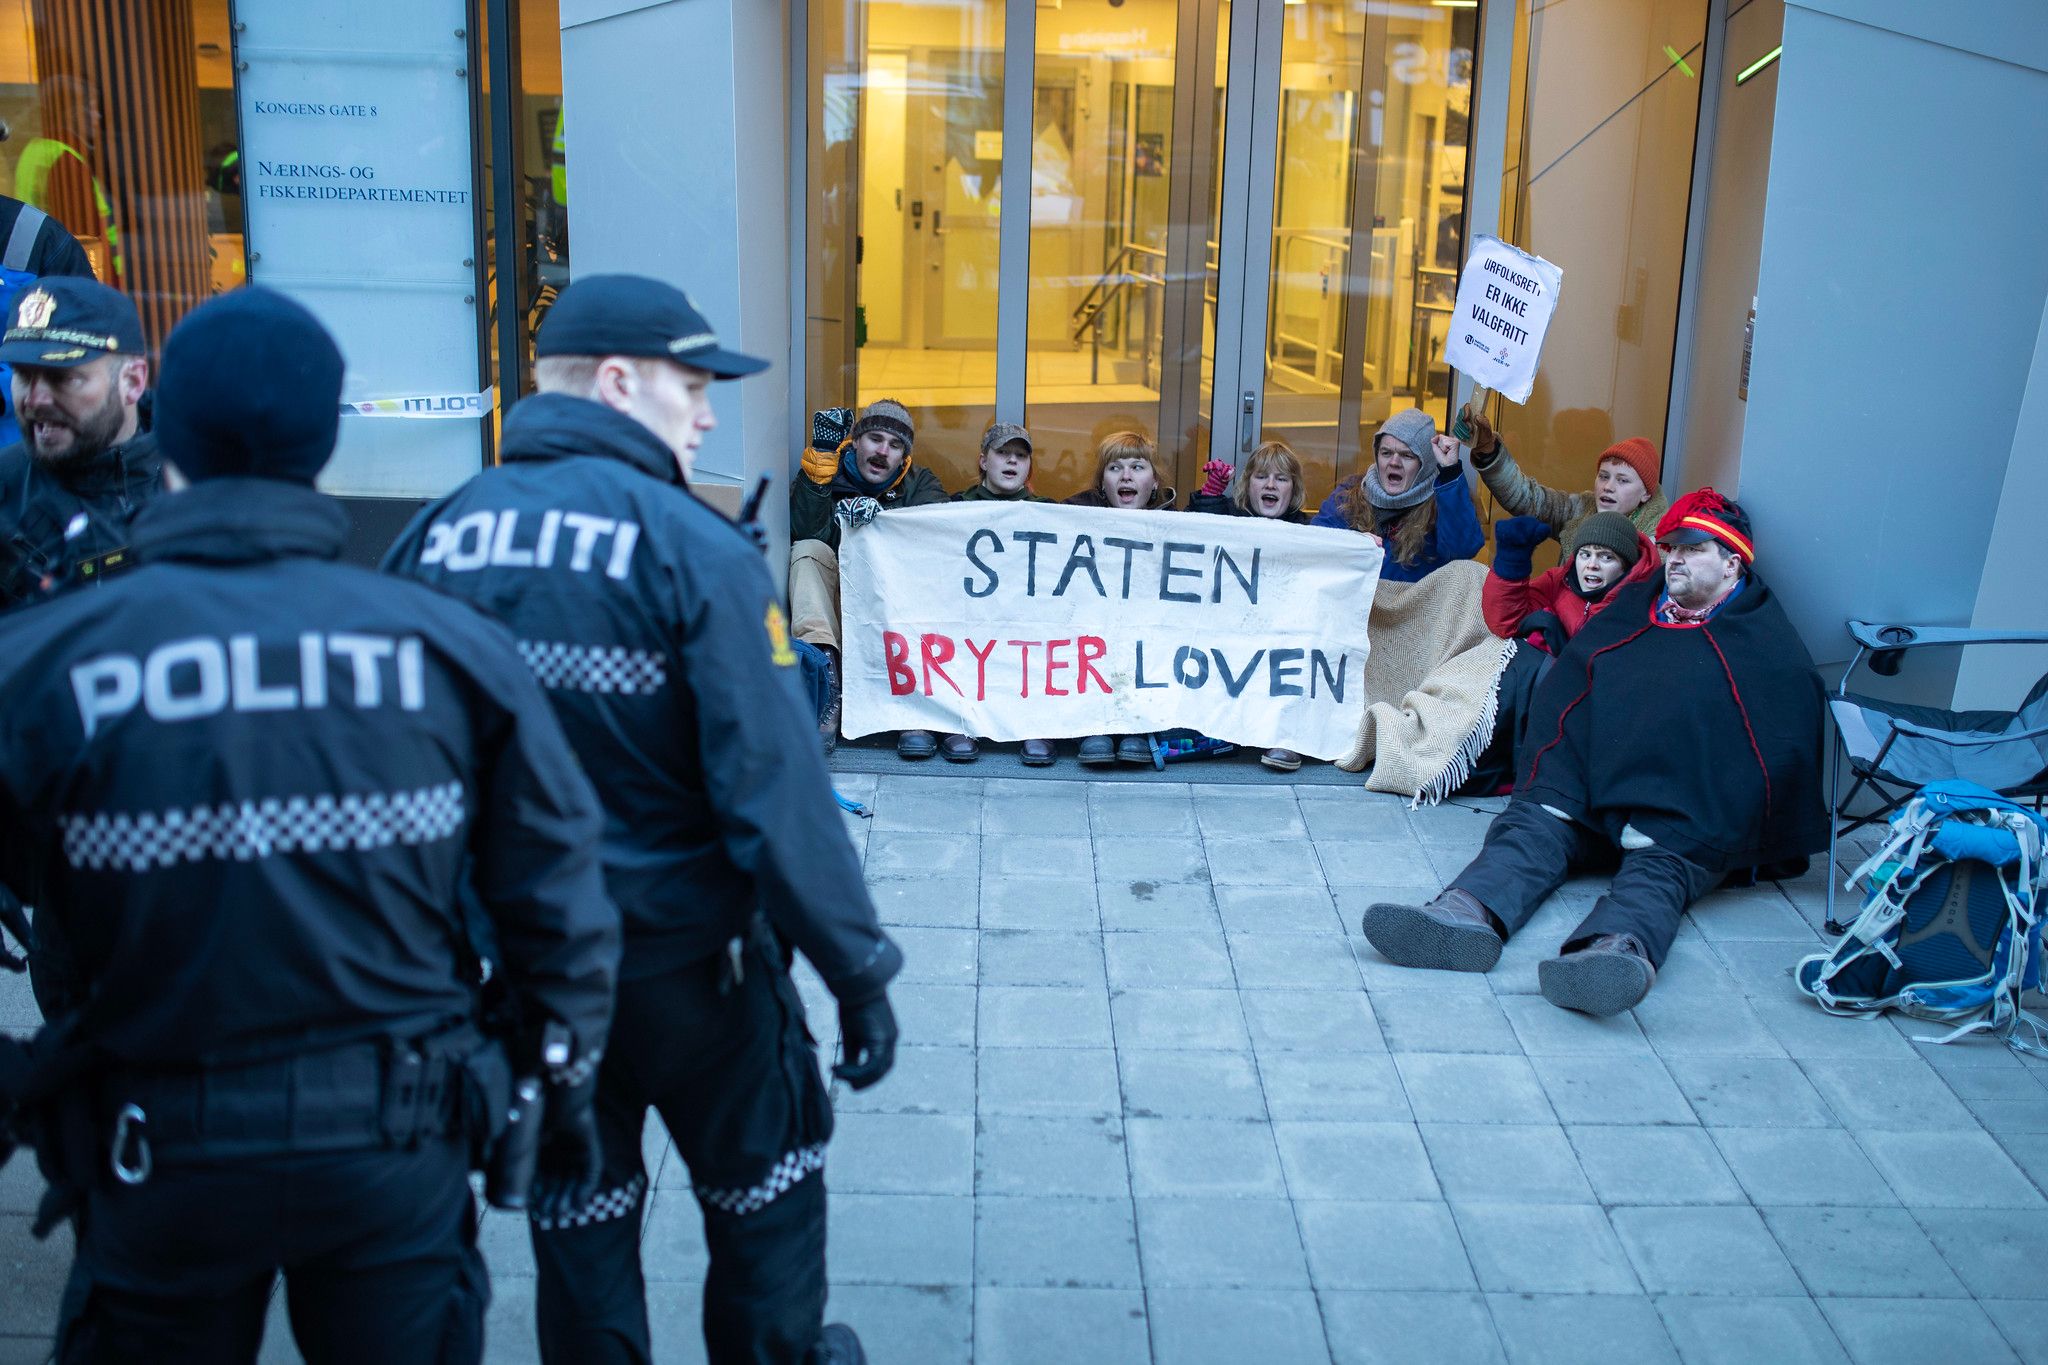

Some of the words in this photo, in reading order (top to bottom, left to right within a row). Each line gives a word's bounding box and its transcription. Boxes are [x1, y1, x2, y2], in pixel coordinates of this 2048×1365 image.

[255, 101, 325, 115] KONGENS
[329, 104, 366, 116] GATE
[370, 106, 377, 116] 8
[258, 161, 345, 178] NÆRINGS-
[350, 166, 374, 179] OG
[259, 185, 468, 204] FISKERIDEPARTEMENTET
[1485, 283, 1500, 304] ER
[1501, 292, 1529, 318] IKKE
[1471, 304, 1529, 346] VALGFRITT
[963, 528, 1261, 604] STATEN
[882, 630, 1113, 702] BRYTER
[1135, 640, 1348, 704] LOVEN
[70, 633, 426, 740] POLITI
